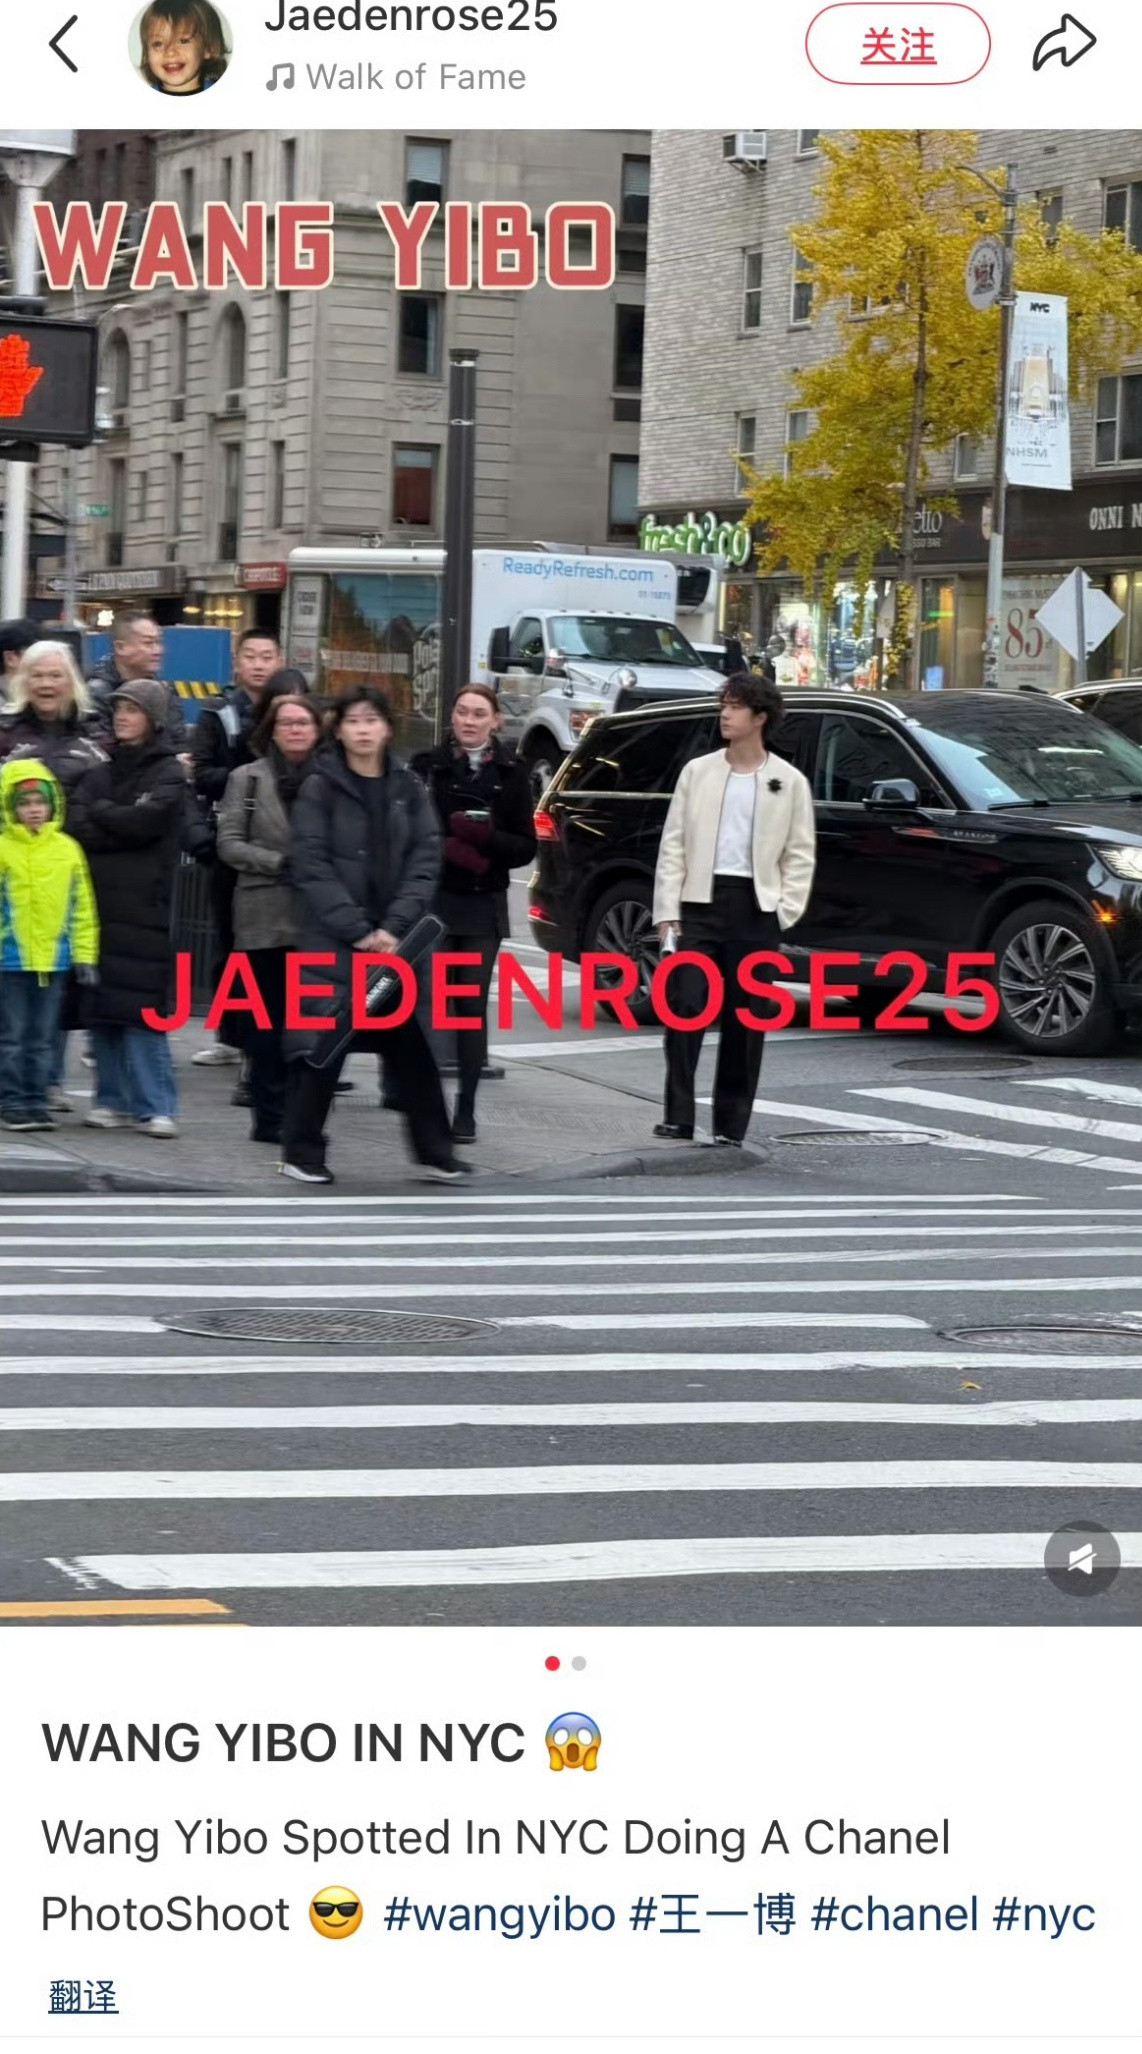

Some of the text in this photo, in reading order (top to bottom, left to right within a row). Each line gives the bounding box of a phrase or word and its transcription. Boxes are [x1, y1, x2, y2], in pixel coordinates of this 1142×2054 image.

[1030, 302, 1050, 313] NYC
[1089, 506, 1123, 530] ONNI
[502, 556, 655, 581] ReadyRefresh.com
